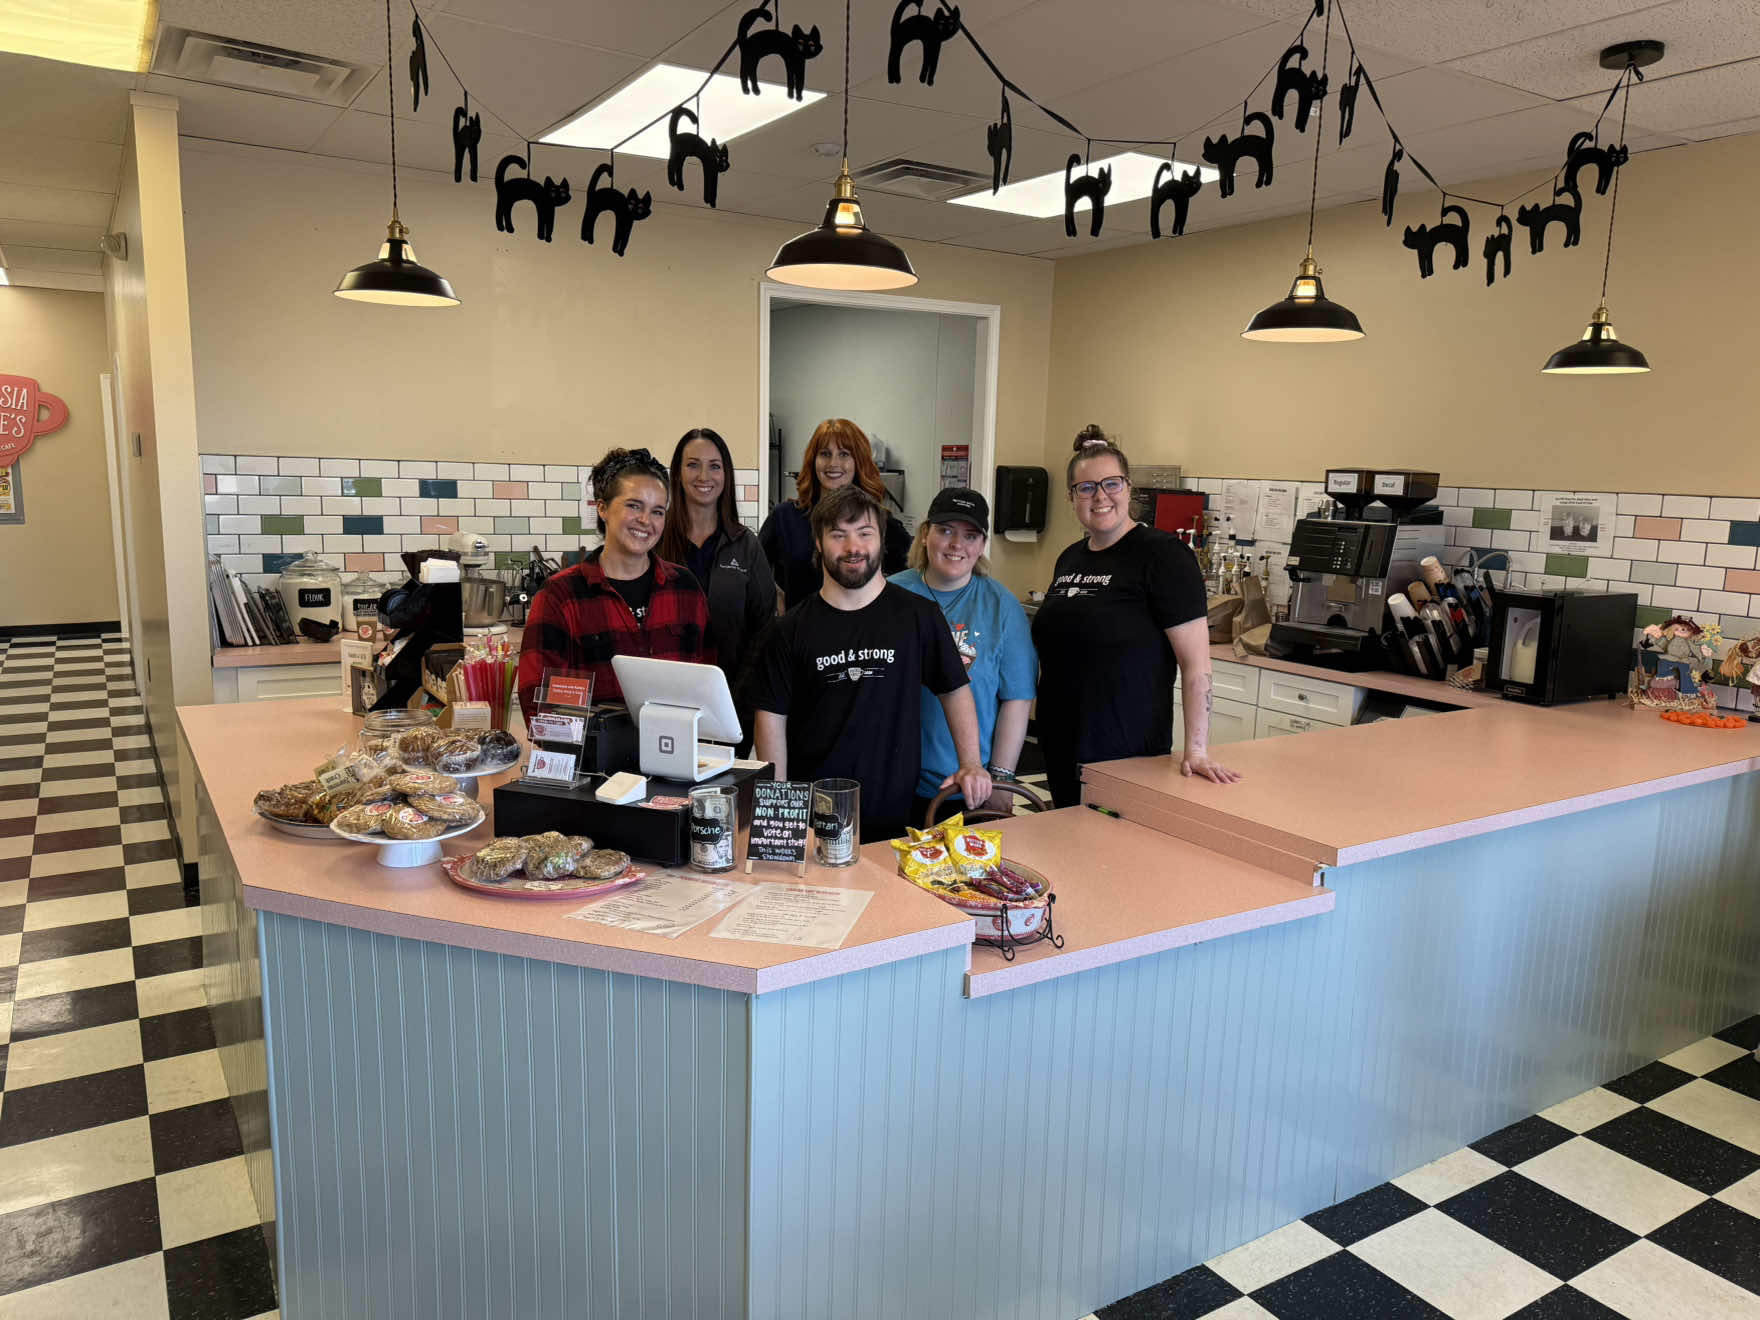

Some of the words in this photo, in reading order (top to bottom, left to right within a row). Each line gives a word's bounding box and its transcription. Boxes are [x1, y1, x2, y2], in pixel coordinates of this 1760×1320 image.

[1381, 481, 1396, 489] Decaf
[1074, 574, 1082, 583] &
[1082, 574, 1112, 586] strong
[816, 650, 846, 671] good
[848, 649, 856, 661] &
[858, 648, 895, 663] strong
[771, 781, 792, 789] YOUR
[755, 788, 809, 801] DONATIONS
[790, 800, 804, 808] OUR
[755, 807, 808, 820] NON-PROFIT
[753, 819, 768, 827] and
[769, 820, 783, 828] you
[784, 821, 797, 829] get
[798, 821, 807, 831] to
[782, 830, 792, 838] on
